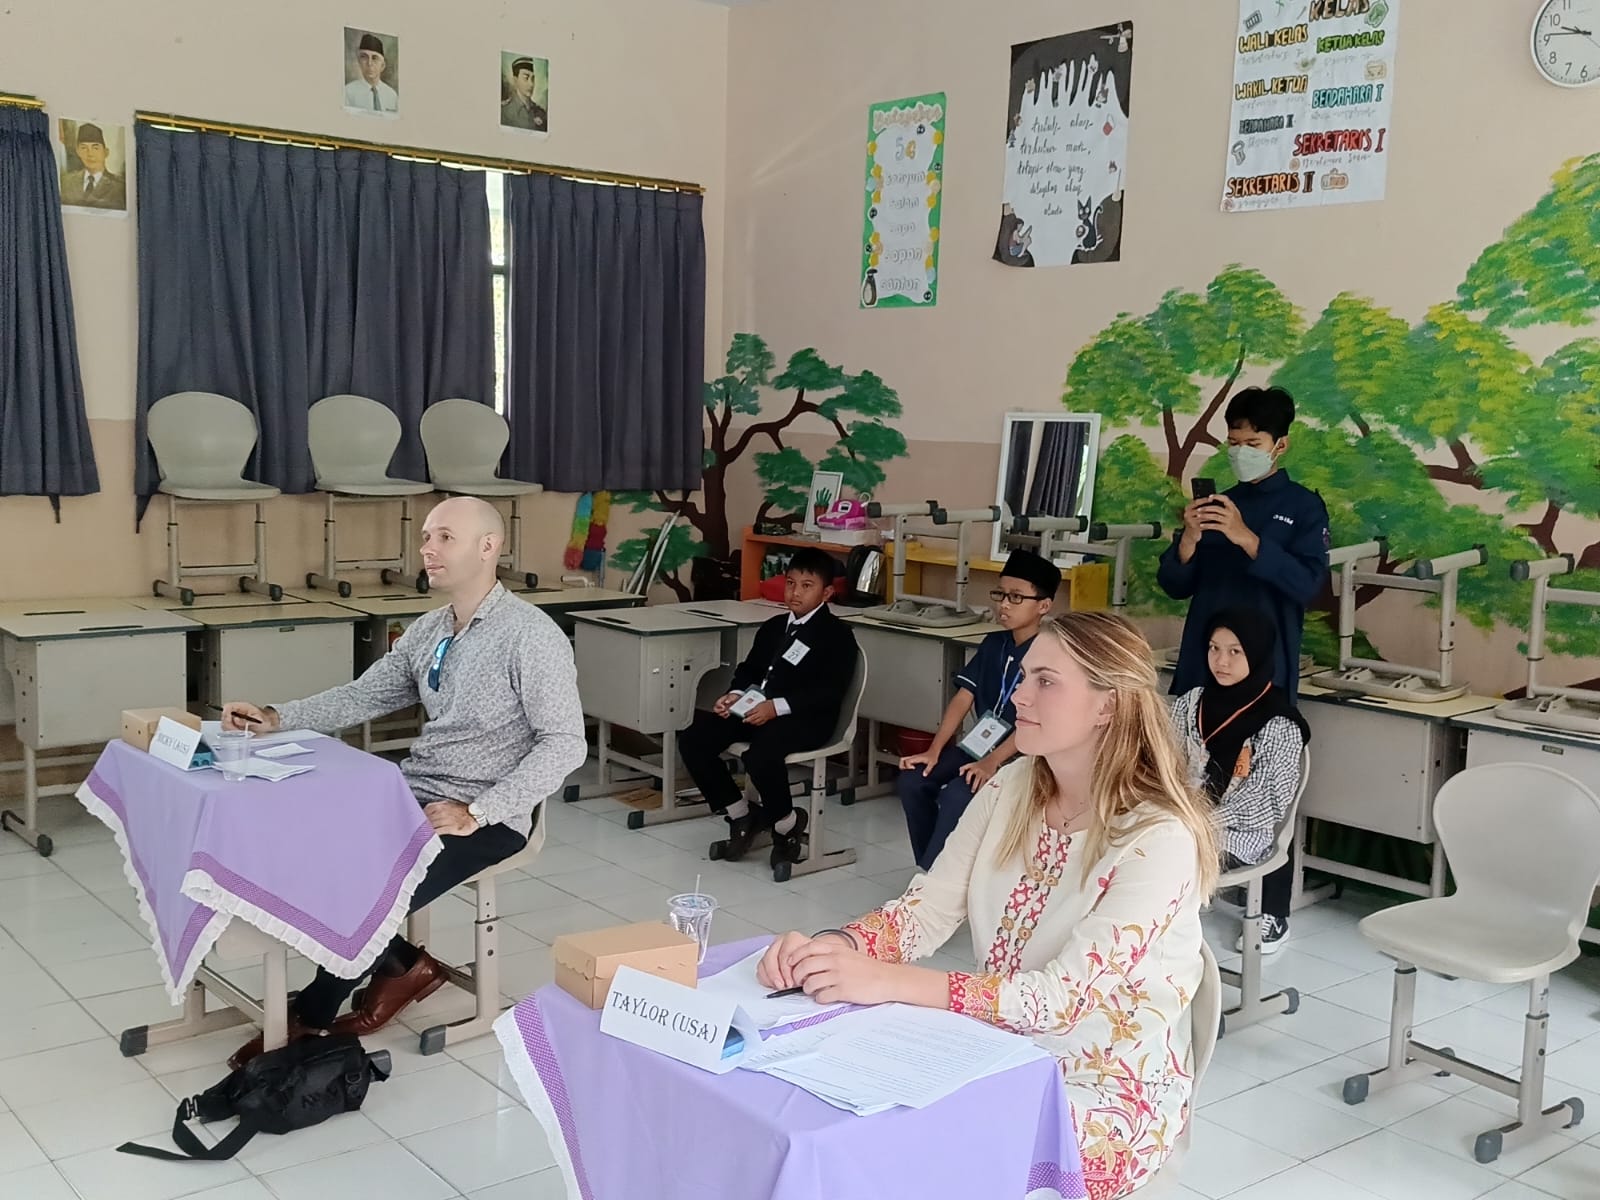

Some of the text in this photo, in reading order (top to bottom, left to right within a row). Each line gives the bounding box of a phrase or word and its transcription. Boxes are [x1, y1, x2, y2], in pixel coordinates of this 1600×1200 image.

[1309, 0, 1370, 22] KELAS
[1550, 13, 1561, 27] 10
[1238, 23, 1309, 54] WALI KELAS
[1316, 29, 1386, 54] KETUA KELAS
[1543, 34, 1551, 46] 9
[1549, 51, 1557, 64] 8
[1565, 62, 1572, 76] 7
[1580, 65, 1588, 79] 6
[1235, 74, 1309, 100] WAKIL KETUA
[1312, 85, 1373, 108] BENDAHARA
[1292, 128, 1372, 157] SEKRETARIS
[1226, 172, 1301, 198] SEKRETARIS
[611, 991, 718, 1044] TAYLOR (USA)
